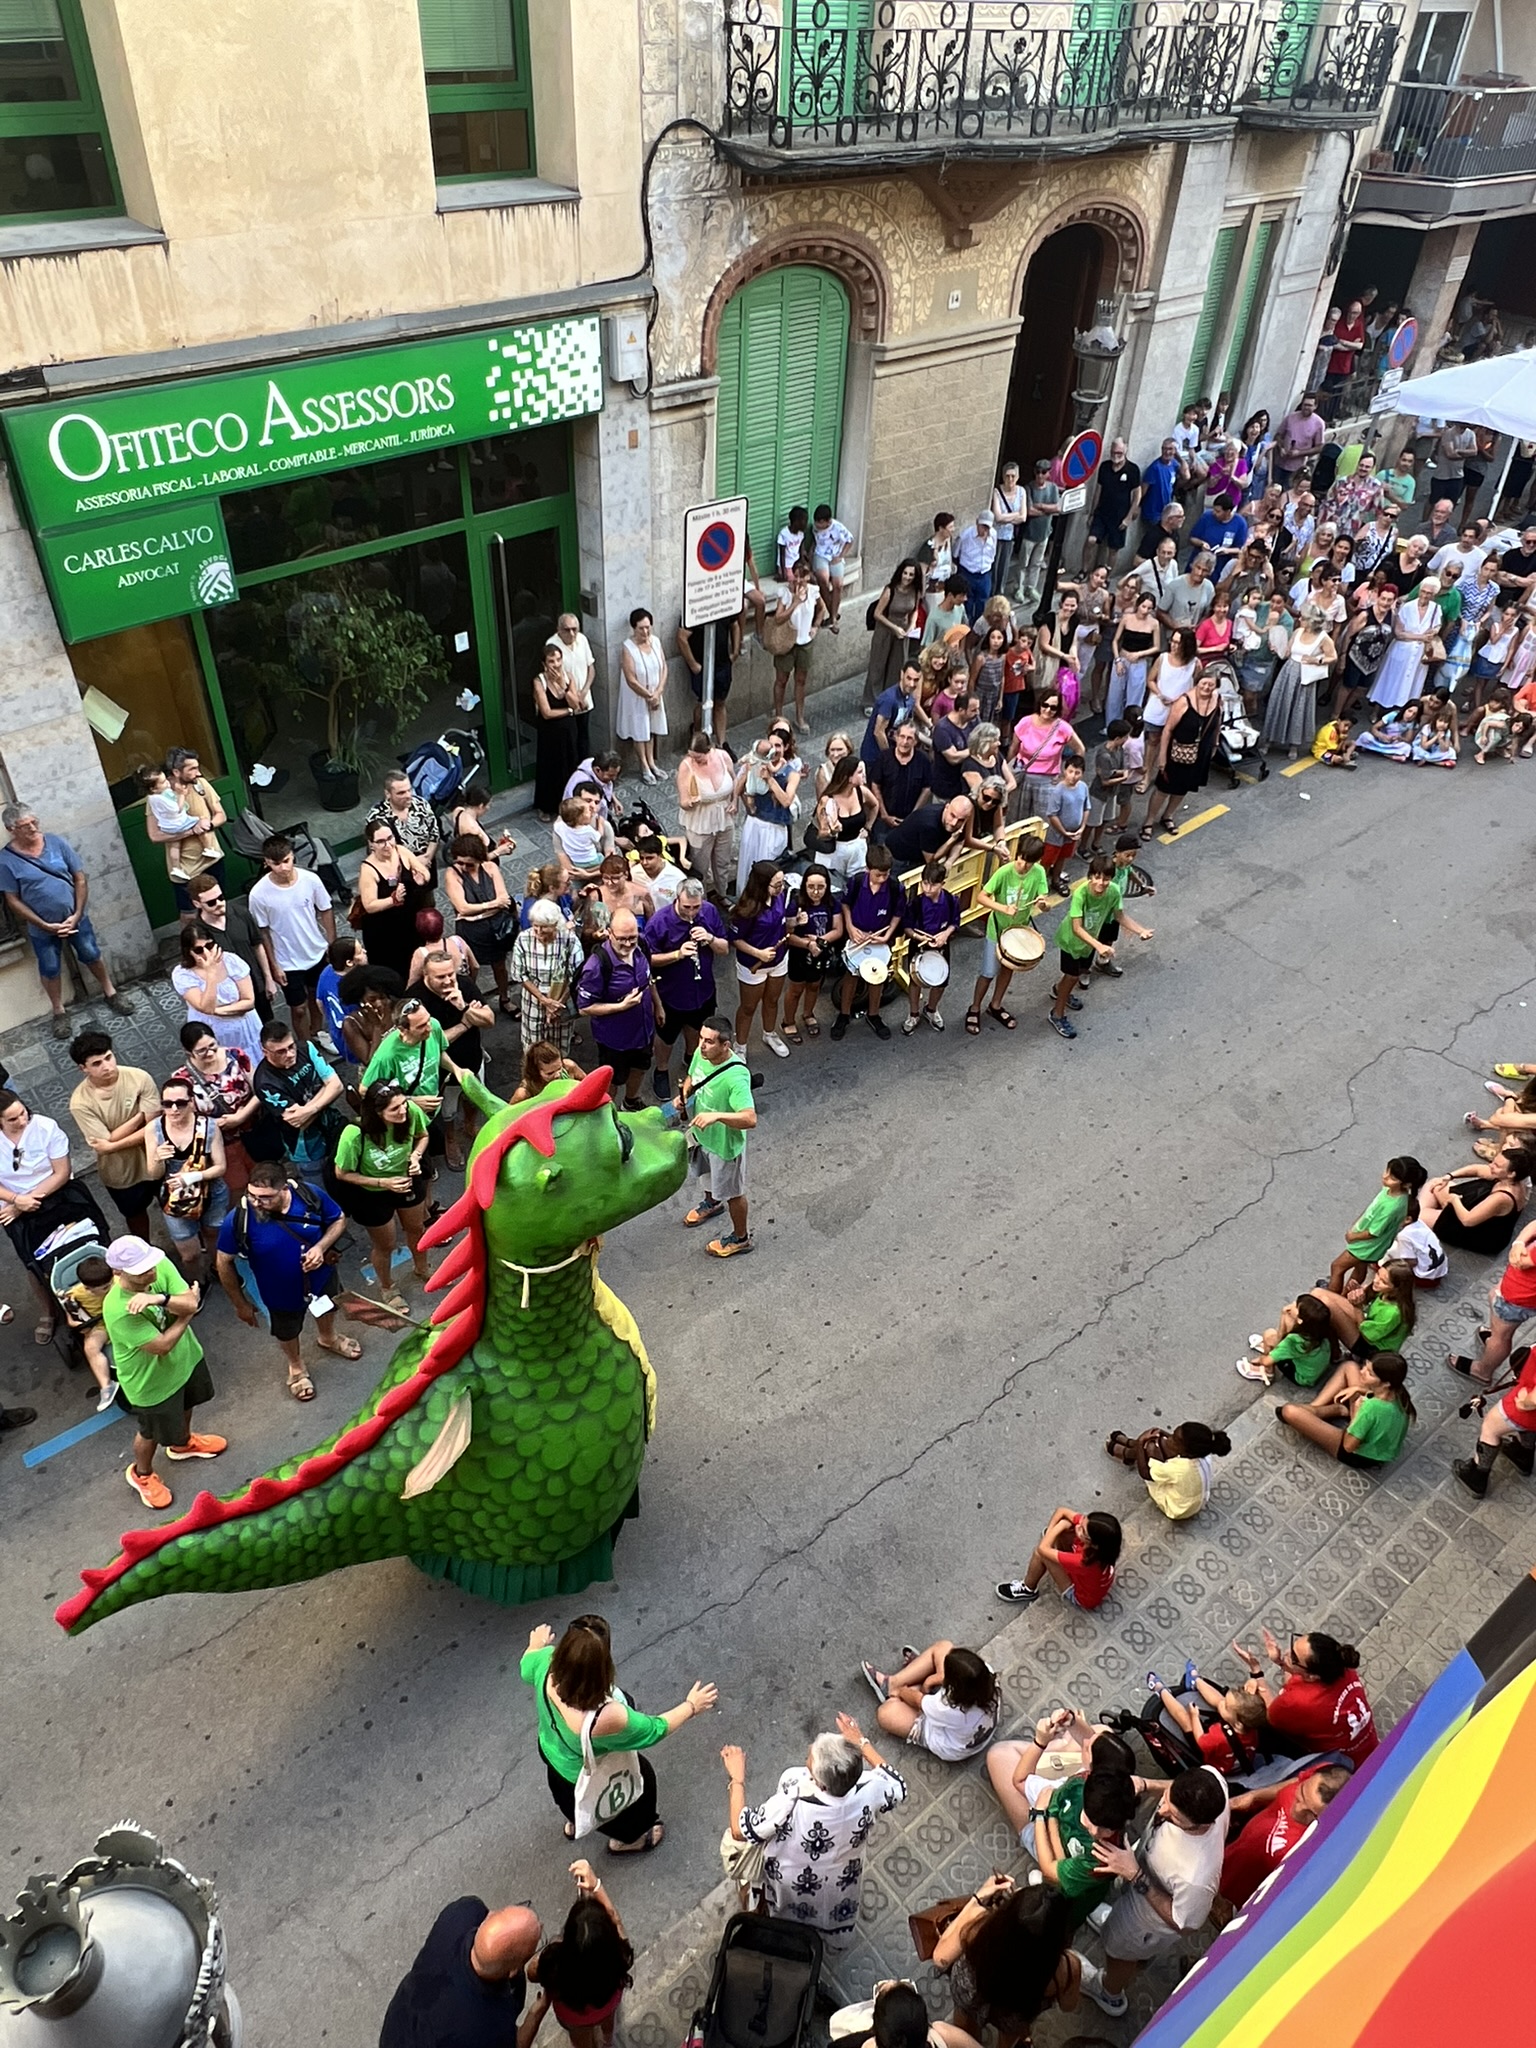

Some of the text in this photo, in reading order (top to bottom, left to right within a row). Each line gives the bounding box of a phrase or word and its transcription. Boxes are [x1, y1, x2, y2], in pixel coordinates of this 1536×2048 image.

[48, 373, 455, 482] OFITECO ASSESSORS
[75, 486, 153, 513] ASSESSORIA
[152, 477, 197, 497] FISCAL
[203, 464, 263, 486] LABORAL
[269, 447, 337, 472] COMPTABLE
[343, 434, 403, 457] MERCANTIL
[408, 423, 456, 443] JURÍDICA
[63, 525, 214, 574] CARLES CALVO
[118, 562, 180, 588] ADVOCAT
[609, 1782, 625, 1815] B
